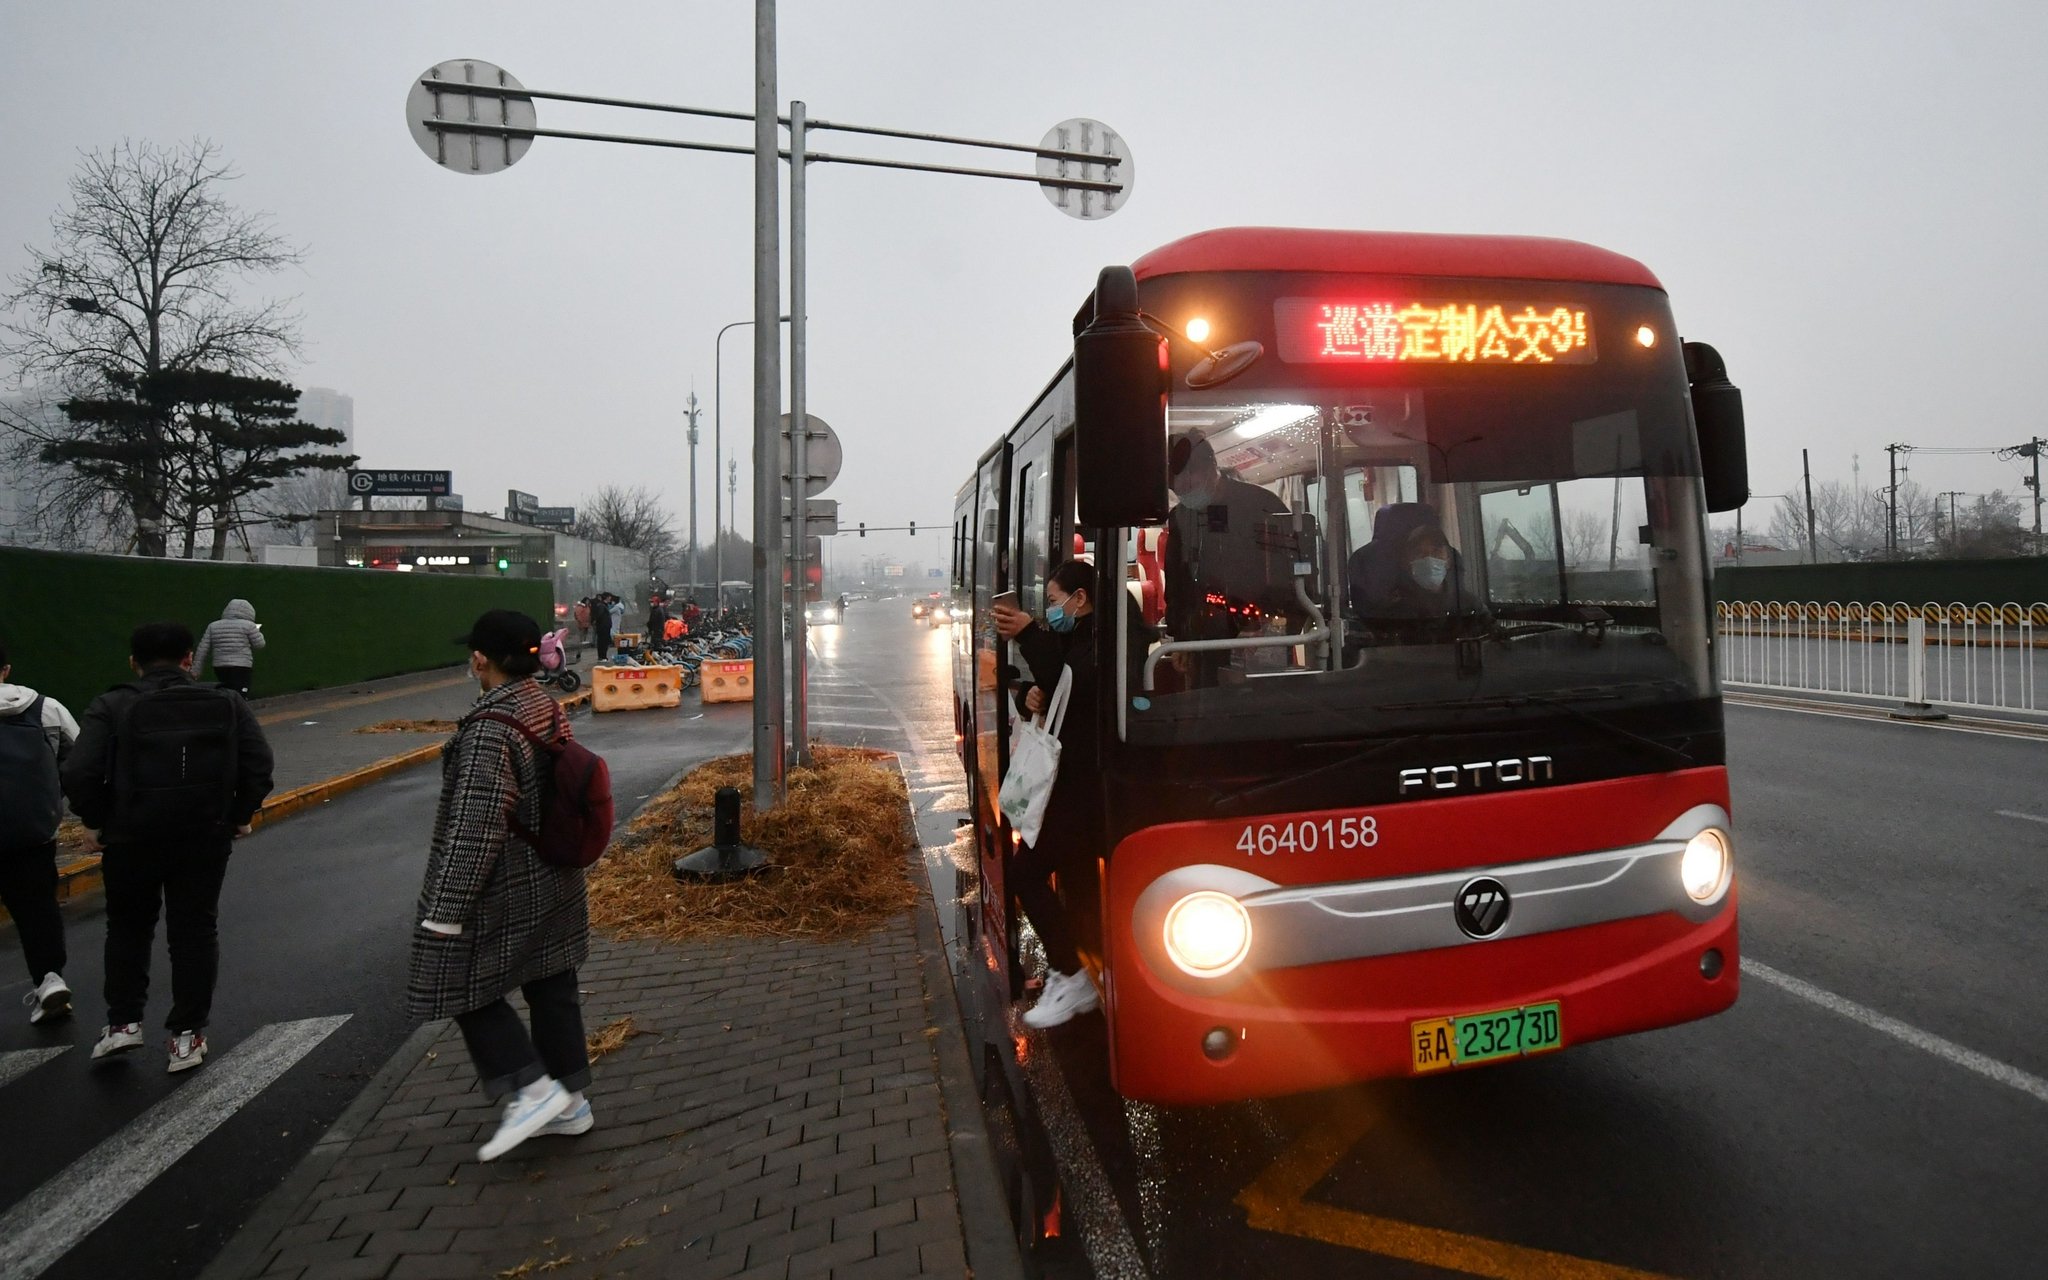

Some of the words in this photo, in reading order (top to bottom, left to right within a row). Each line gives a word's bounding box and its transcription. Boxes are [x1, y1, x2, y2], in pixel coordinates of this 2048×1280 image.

[377, 473, 445, 482] 地铁小红门站
[1399, 755, 1553, 794] FOTON
[1236, 816, 1379, 856] 4640158
